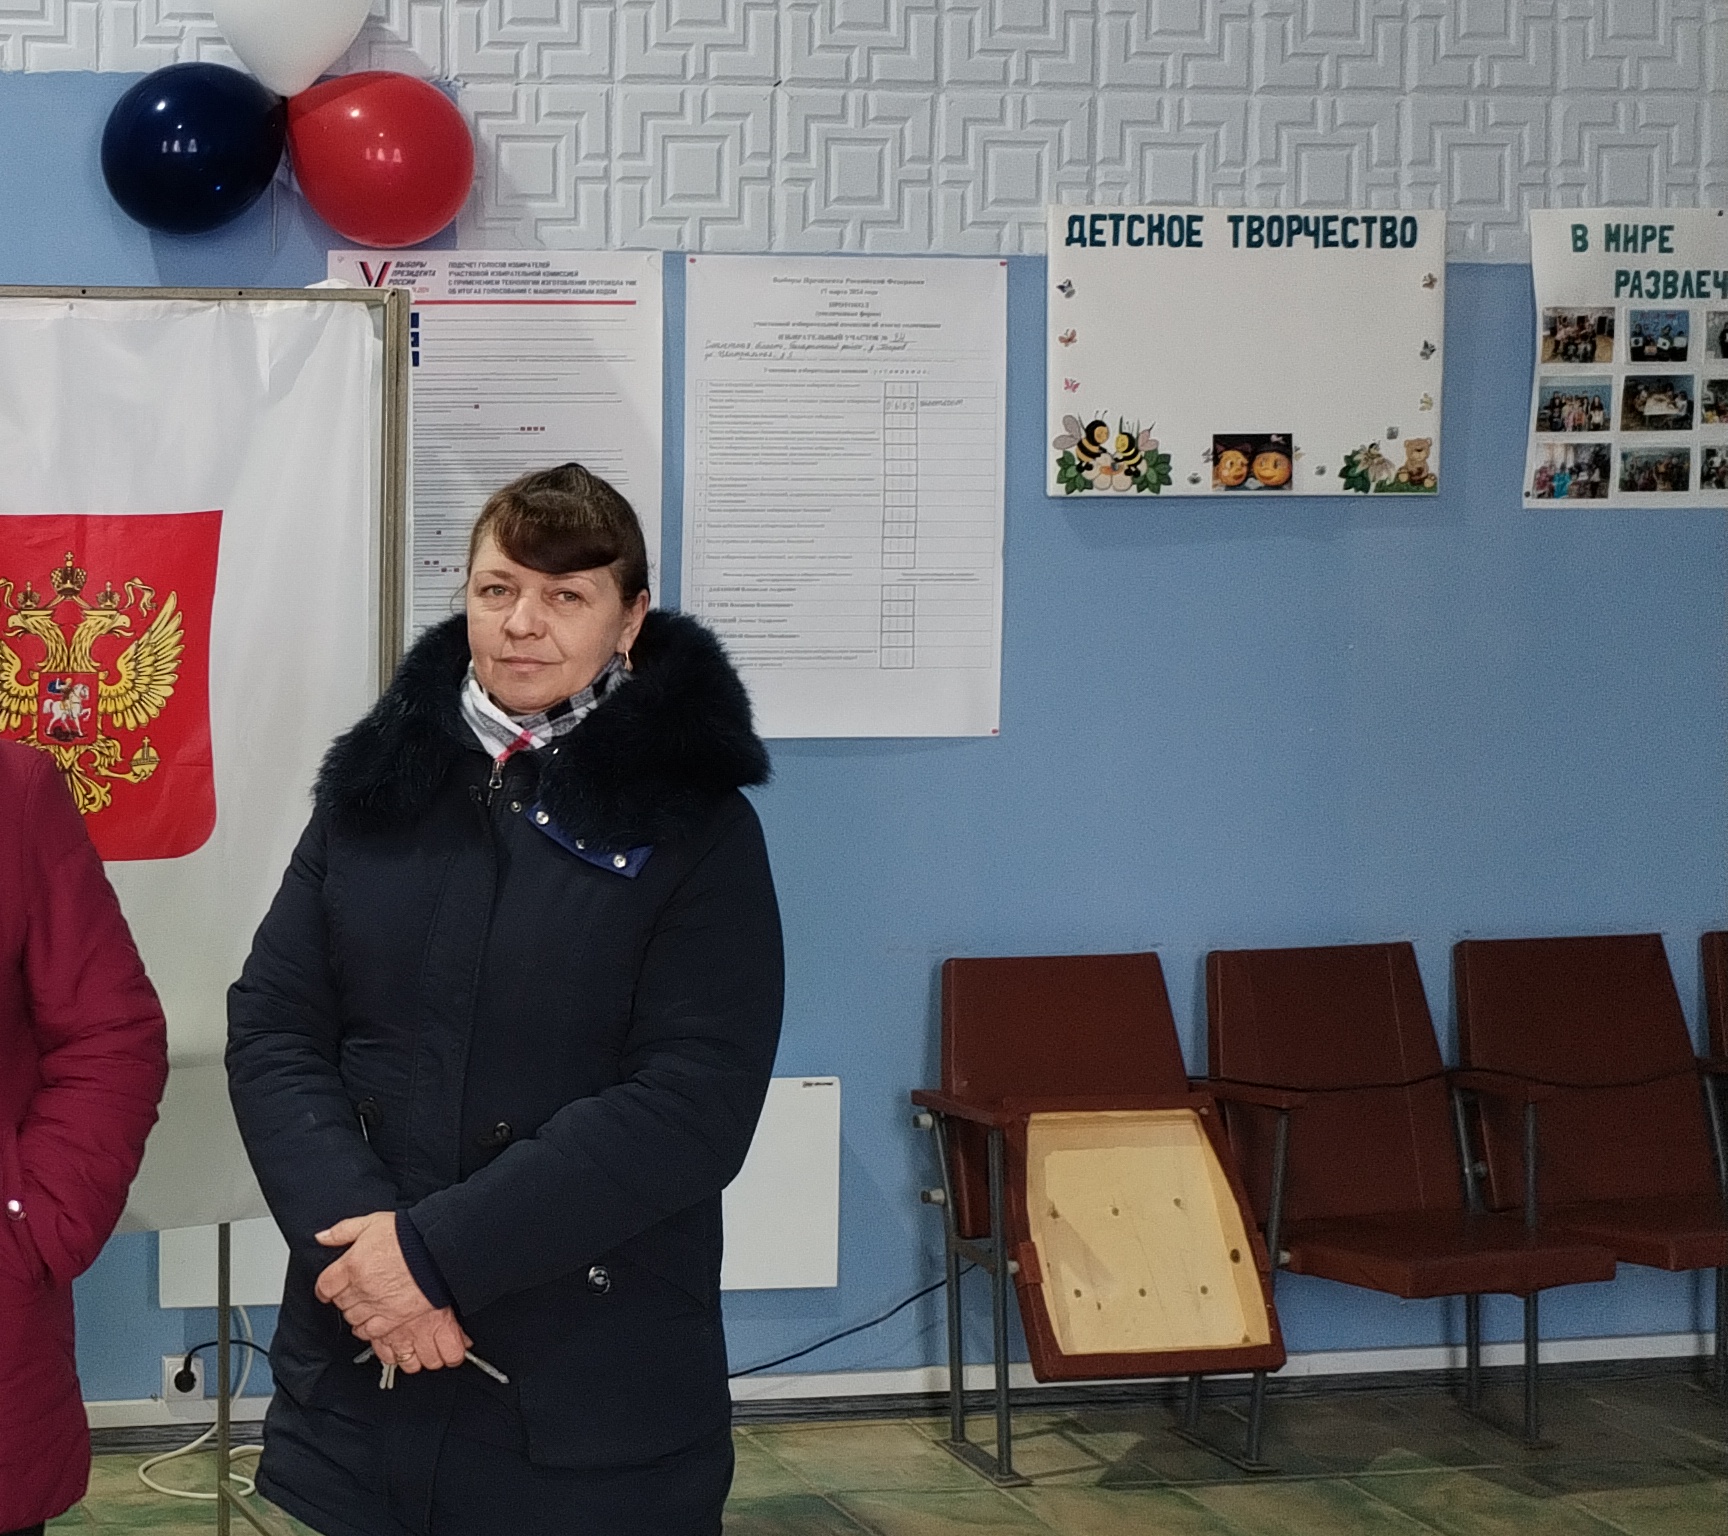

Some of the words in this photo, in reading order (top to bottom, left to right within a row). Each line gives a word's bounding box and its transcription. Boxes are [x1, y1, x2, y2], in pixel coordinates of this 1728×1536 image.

[1064, 212, 1204, 248] ДЕТСКОЕ
[1226, 213, 1418, 249] ТВОРЧЕСТВО
[1570, 223, 1589, 253] В
[1604, 222, 1675, 254] МИРЕ
[391, 269, 437, 278] ПРЕЗИДЕНТА
